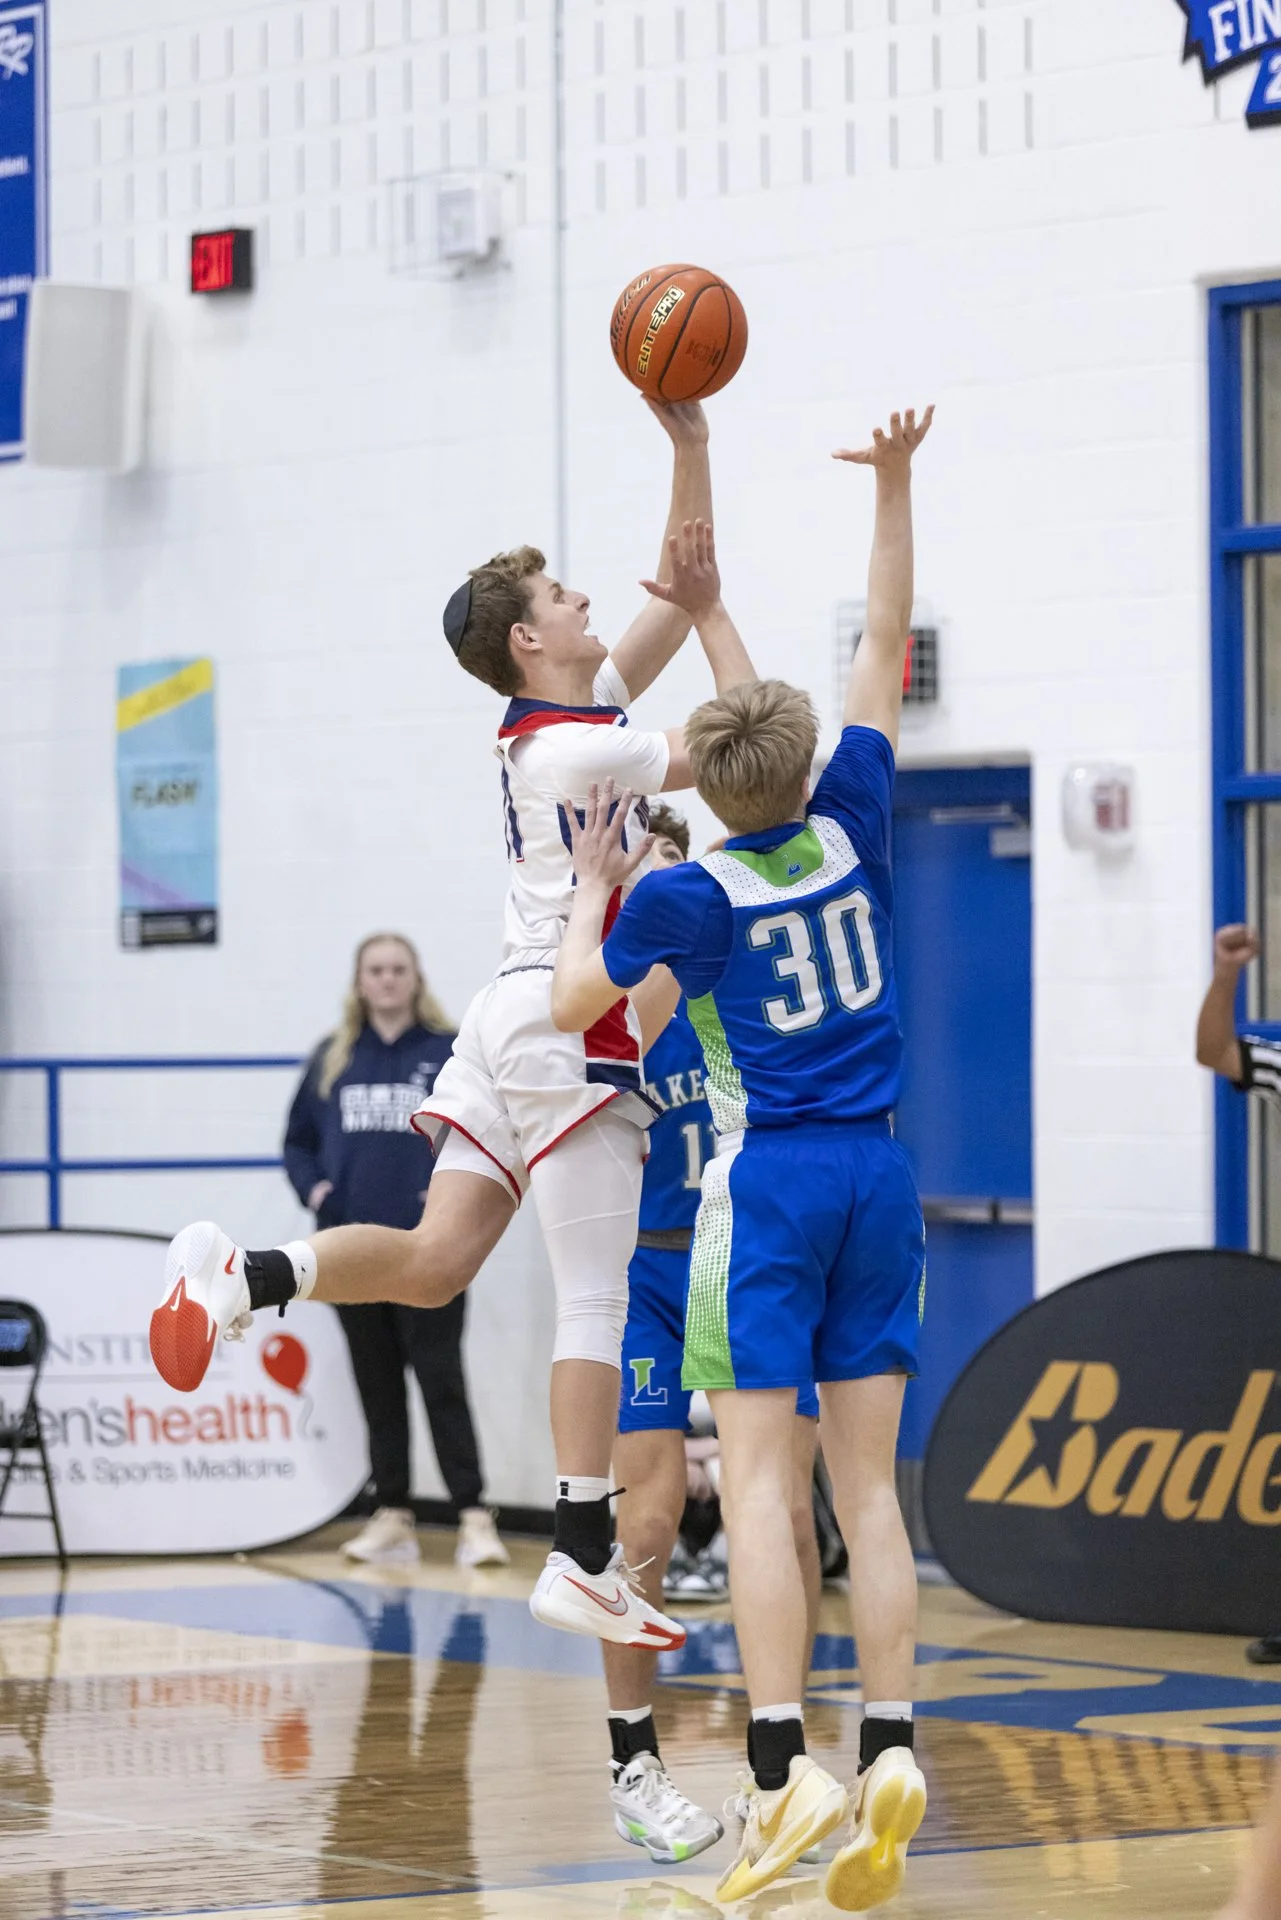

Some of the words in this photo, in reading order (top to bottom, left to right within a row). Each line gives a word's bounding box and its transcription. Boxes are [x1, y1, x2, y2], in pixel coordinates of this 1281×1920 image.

[747, 886, 884, 1037] 30
[629, 1358, 668, 1406] L
[91, 1456, 178, 1489] Sports
[182, 1456, 296, 1482] Medicine
